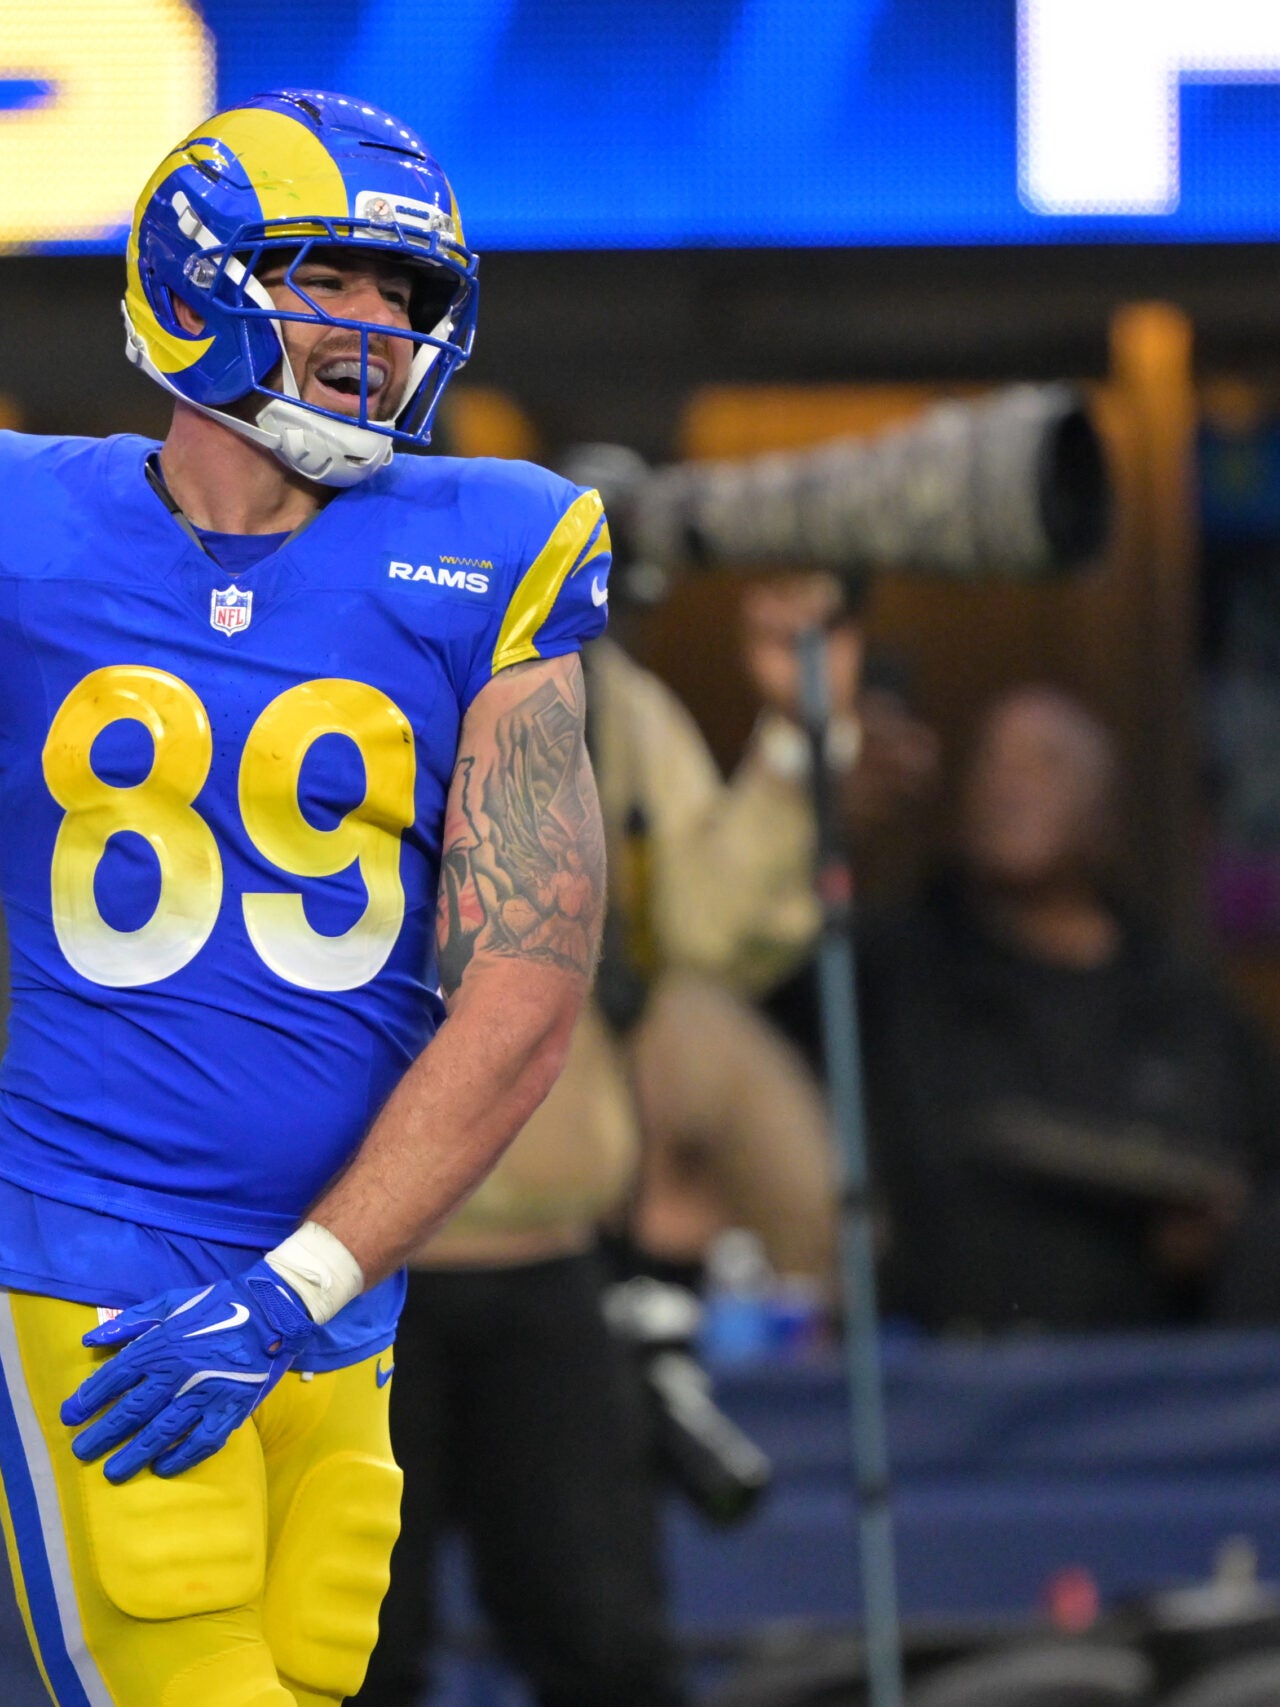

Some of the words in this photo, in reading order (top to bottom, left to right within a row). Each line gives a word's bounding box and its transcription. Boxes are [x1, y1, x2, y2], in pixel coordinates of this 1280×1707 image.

[389, 561, 490, 594] RAMS
[217, 608, 244, 627] NFL
[41, 664, 417, 992] 89
